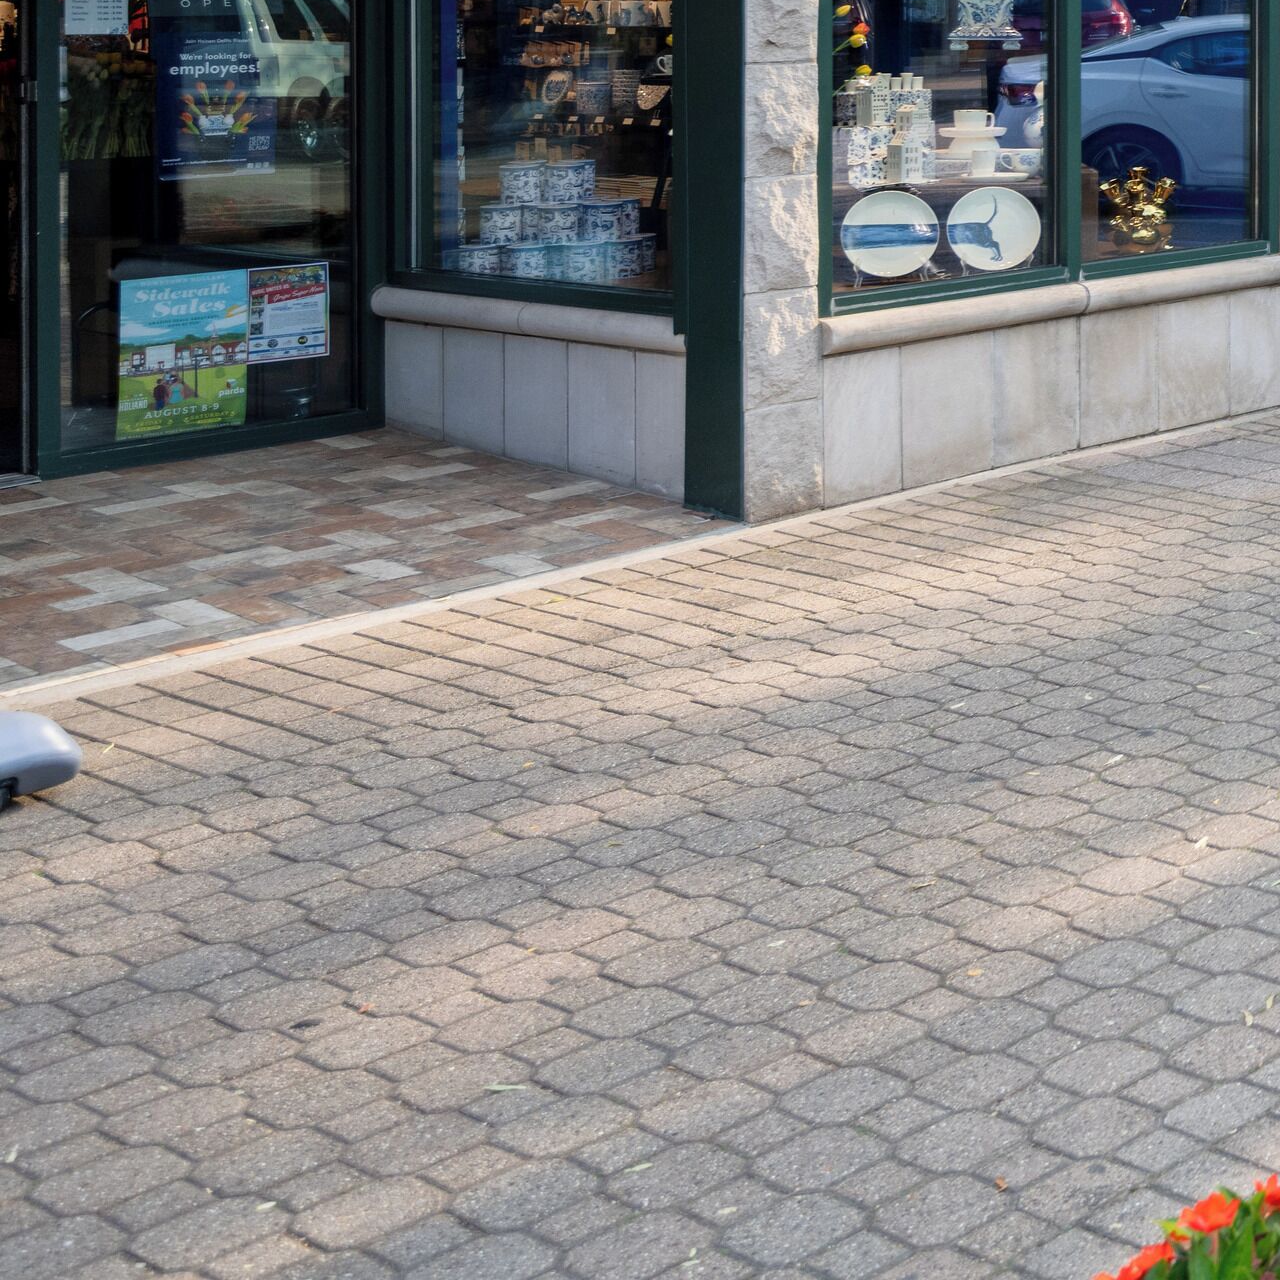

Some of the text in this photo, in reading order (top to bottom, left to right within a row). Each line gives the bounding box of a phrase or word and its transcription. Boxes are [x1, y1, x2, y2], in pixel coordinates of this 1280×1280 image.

[179, 51, 252, 62] We're looking for
[169, 60, 261, 79] employees!
[134, 282, 231, 303] Sidewalk
[152, 297, 227, 319] Sales
[218, 386, 245, 398] parda
[144, 405, 198, 420] AUGUST
